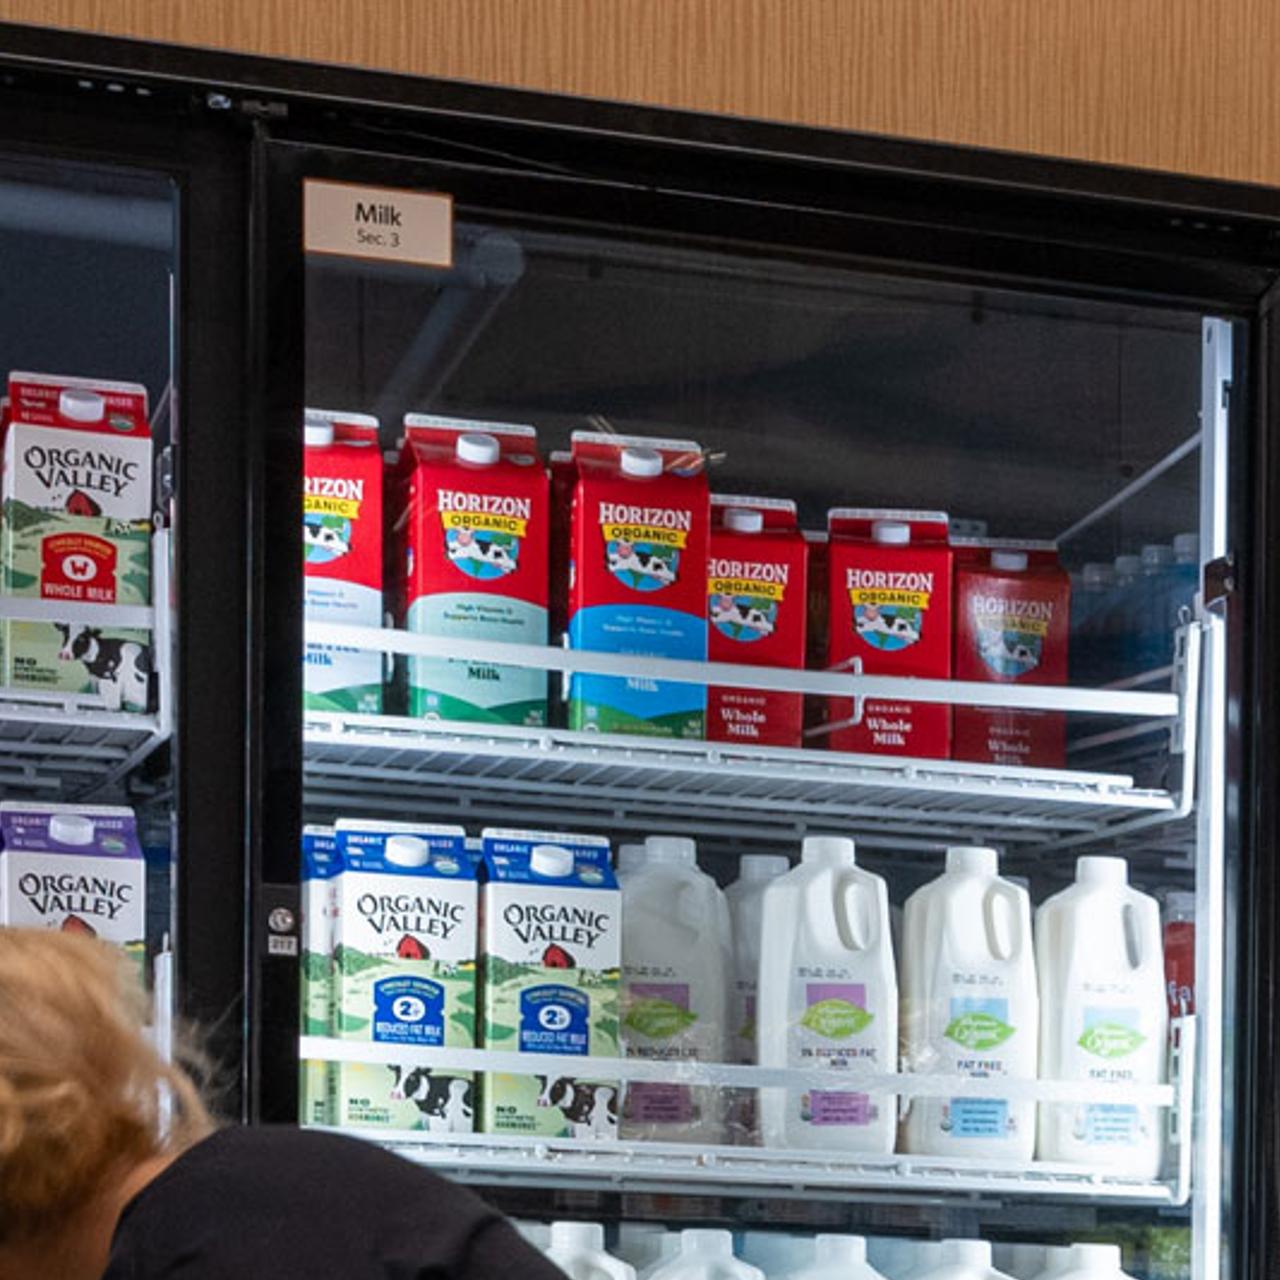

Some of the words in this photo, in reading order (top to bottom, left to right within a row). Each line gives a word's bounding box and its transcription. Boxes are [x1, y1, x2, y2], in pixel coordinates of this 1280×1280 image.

[355, 202, 401, 228] Milk
[357, 230, 386, 247] Sec.
[388, 231, 400, 247] 3
[24, 445, 138, 481] ORGANIC
[35, 467, 128, 497] VALLEY
[304, 476, 364, 501] RIZON
[304, 498, 349, 513] GANIC
[437, 489, 531, 519] HORIZON
[451, 514, 518, 532] ORGANIC
[598, 502, 692, 531] HORIZON
[612, 526, 678, 543] ORGANIC
[708, 557, 789, 583] HORIZON
[846, 568, 934, 592] HORIZON
[44, 583, 82, 598] WHOLE
[86, 586, 114, 600] MILK
[714, 581, 776, 596] ORGANIC
[858, 591, 921, 606] ORGANIC
[972, 594, 1054, 620] HORIZON
[467, 667, 501, 681] Milk
[720, 708, 766, 724] Whole
[866, 718, 913, 733] Whole
[727, 723, 760, 738] Milk
[873, 732, 907, 746] Milk
[988, 740, 1031, 754] Whole
[18, 873, 133, 903] ORGANIC
[29, 895, 124, 920] VALLEY
[357, 893, 465, 924] ORGANIC
[504, 903, 609, 932] ORGANIC
[367, 912, 455, 939] VALLEY
[513, 924, 599, 949] VALLEY
[957, 1060, 976, 1071] FAT
